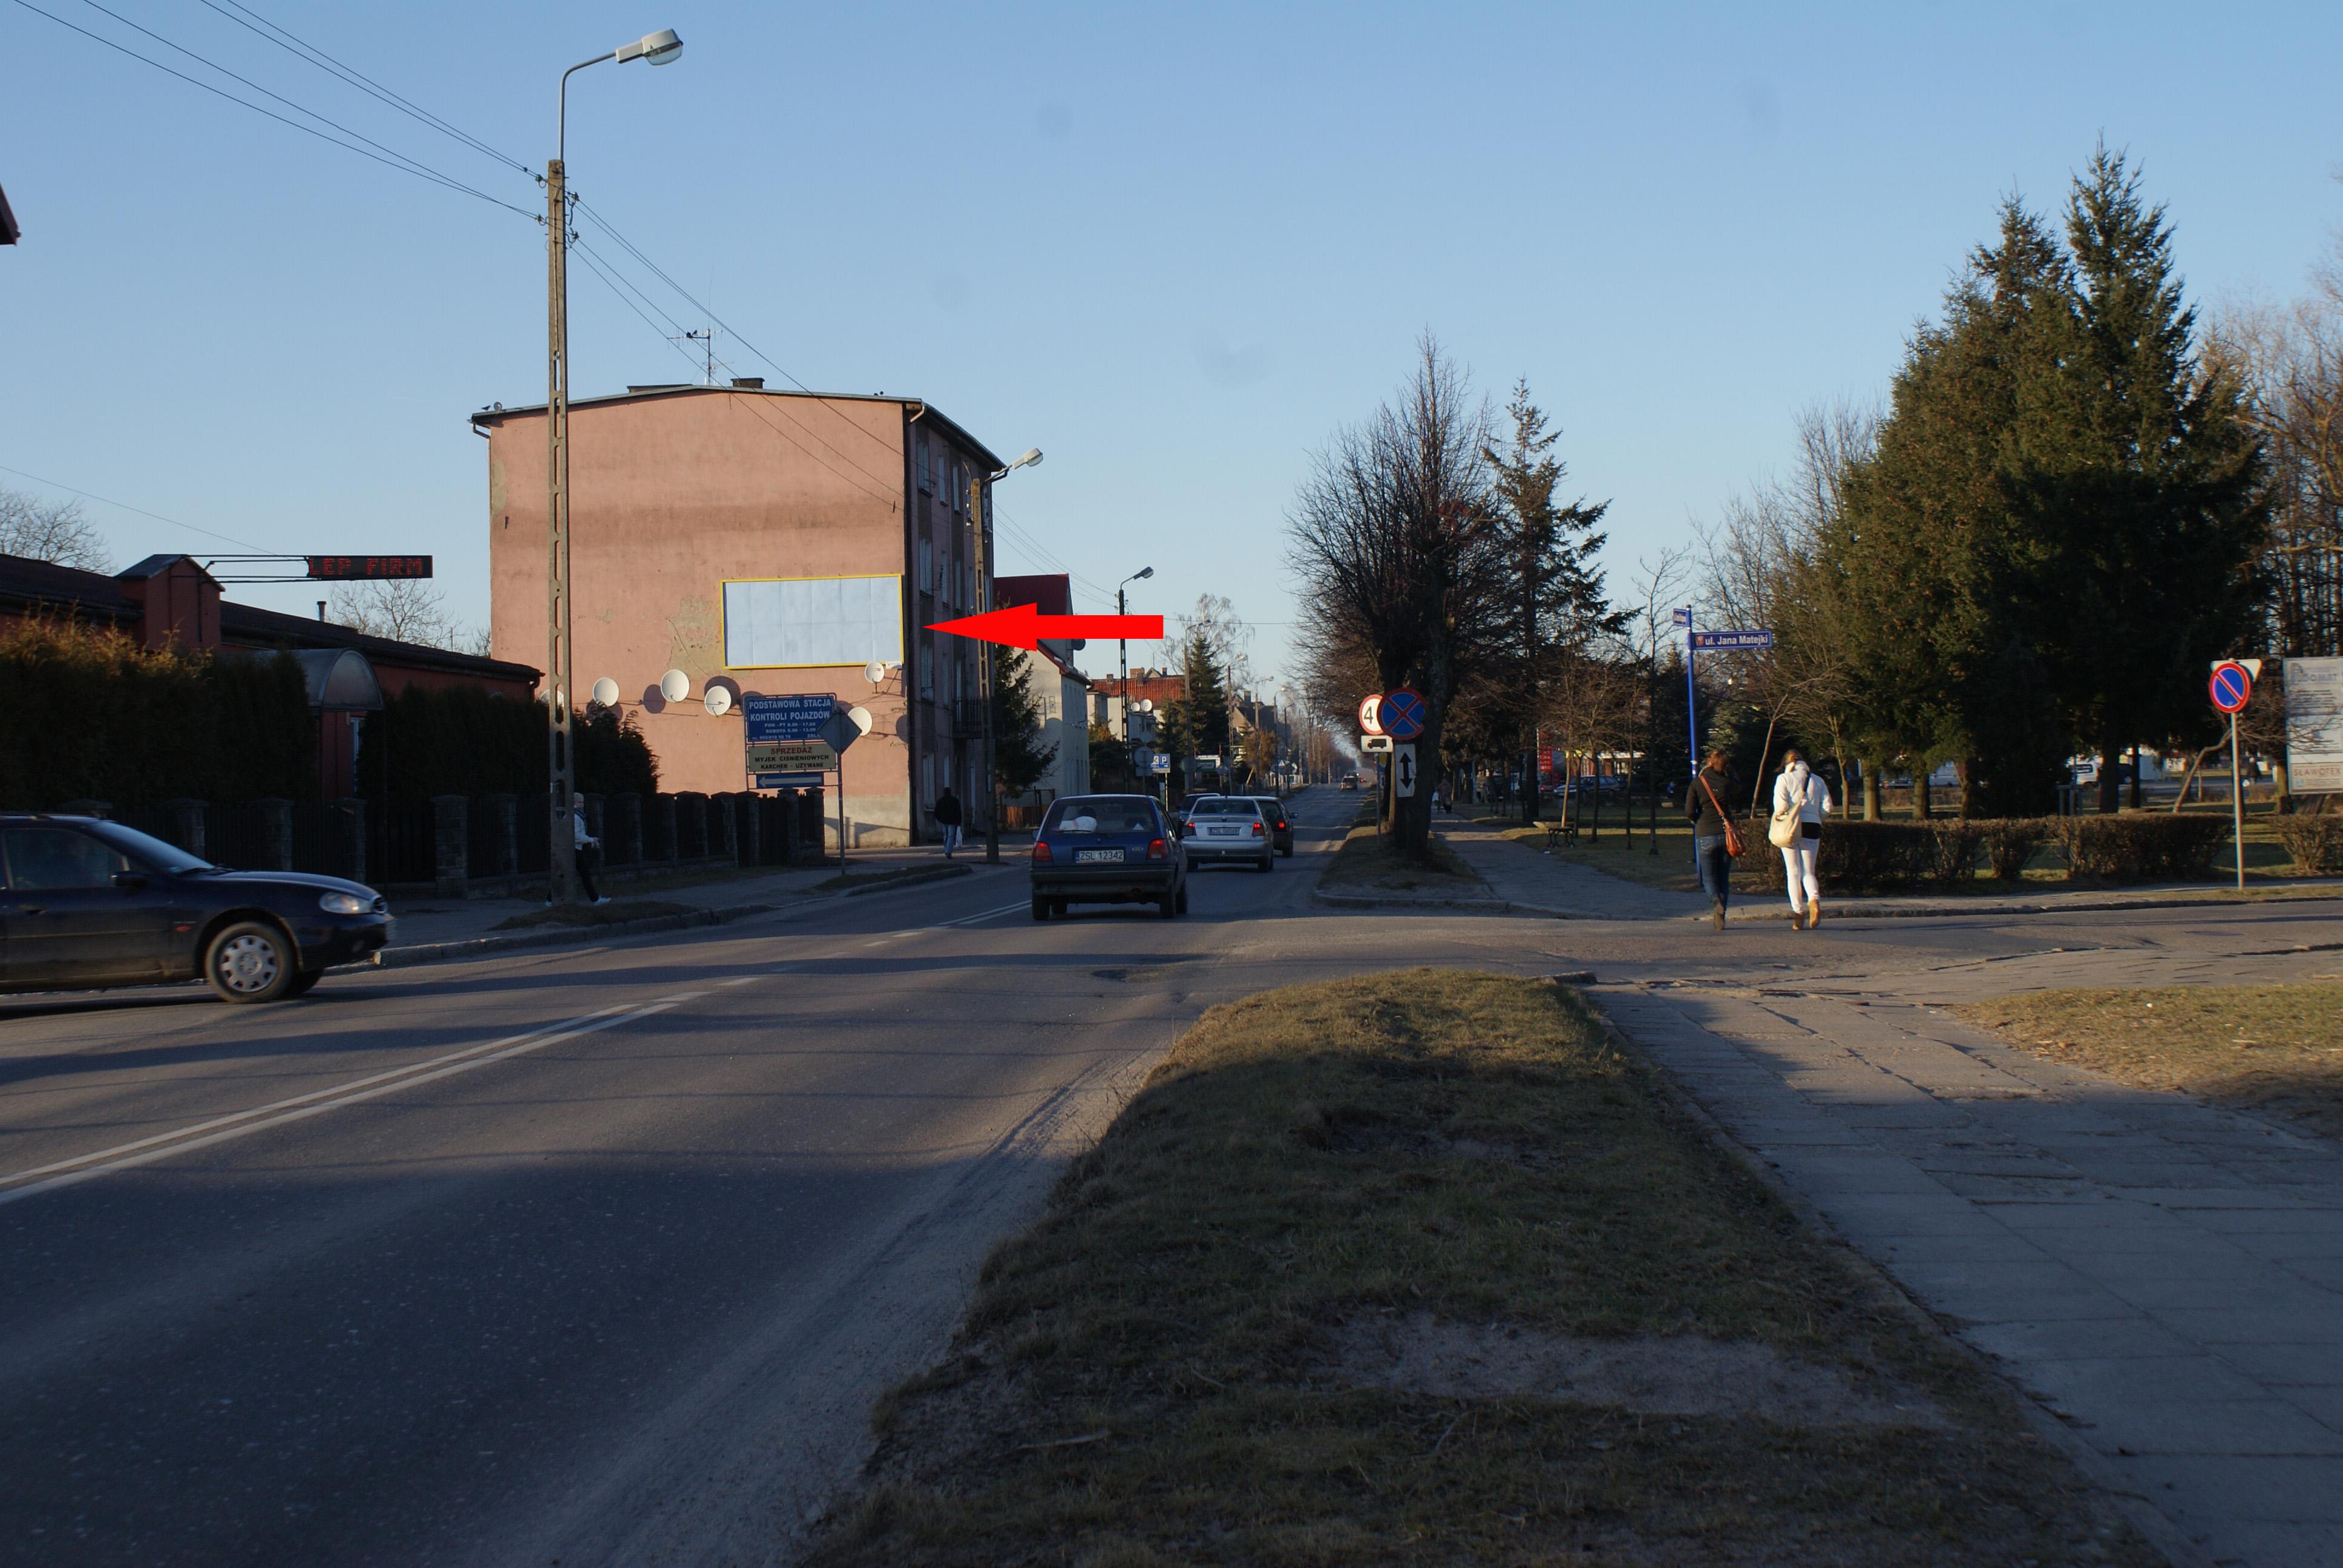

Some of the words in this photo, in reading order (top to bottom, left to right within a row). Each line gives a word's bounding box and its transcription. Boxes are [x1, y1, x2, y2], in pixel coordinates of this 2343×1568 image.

[309, 558, 352, 575] LEP
[367, 558, 423, 575] FIRM
[1705, 637, 1715, 645] ul.
[1717, 636, 1737, 645] Jana
[1739, 635, 1768, 645] Matejki
[749, 700, 801, 710] PODSTAWOWA
[804, 699, 831, 707] STACJA
[750, 713, 787, 721] KONTROLI
[790, 709, 830, 719] POJAZDÓW
[1080, 852, 1095, 860] ZSL
[1099, 851, 1123, 860] 12342
